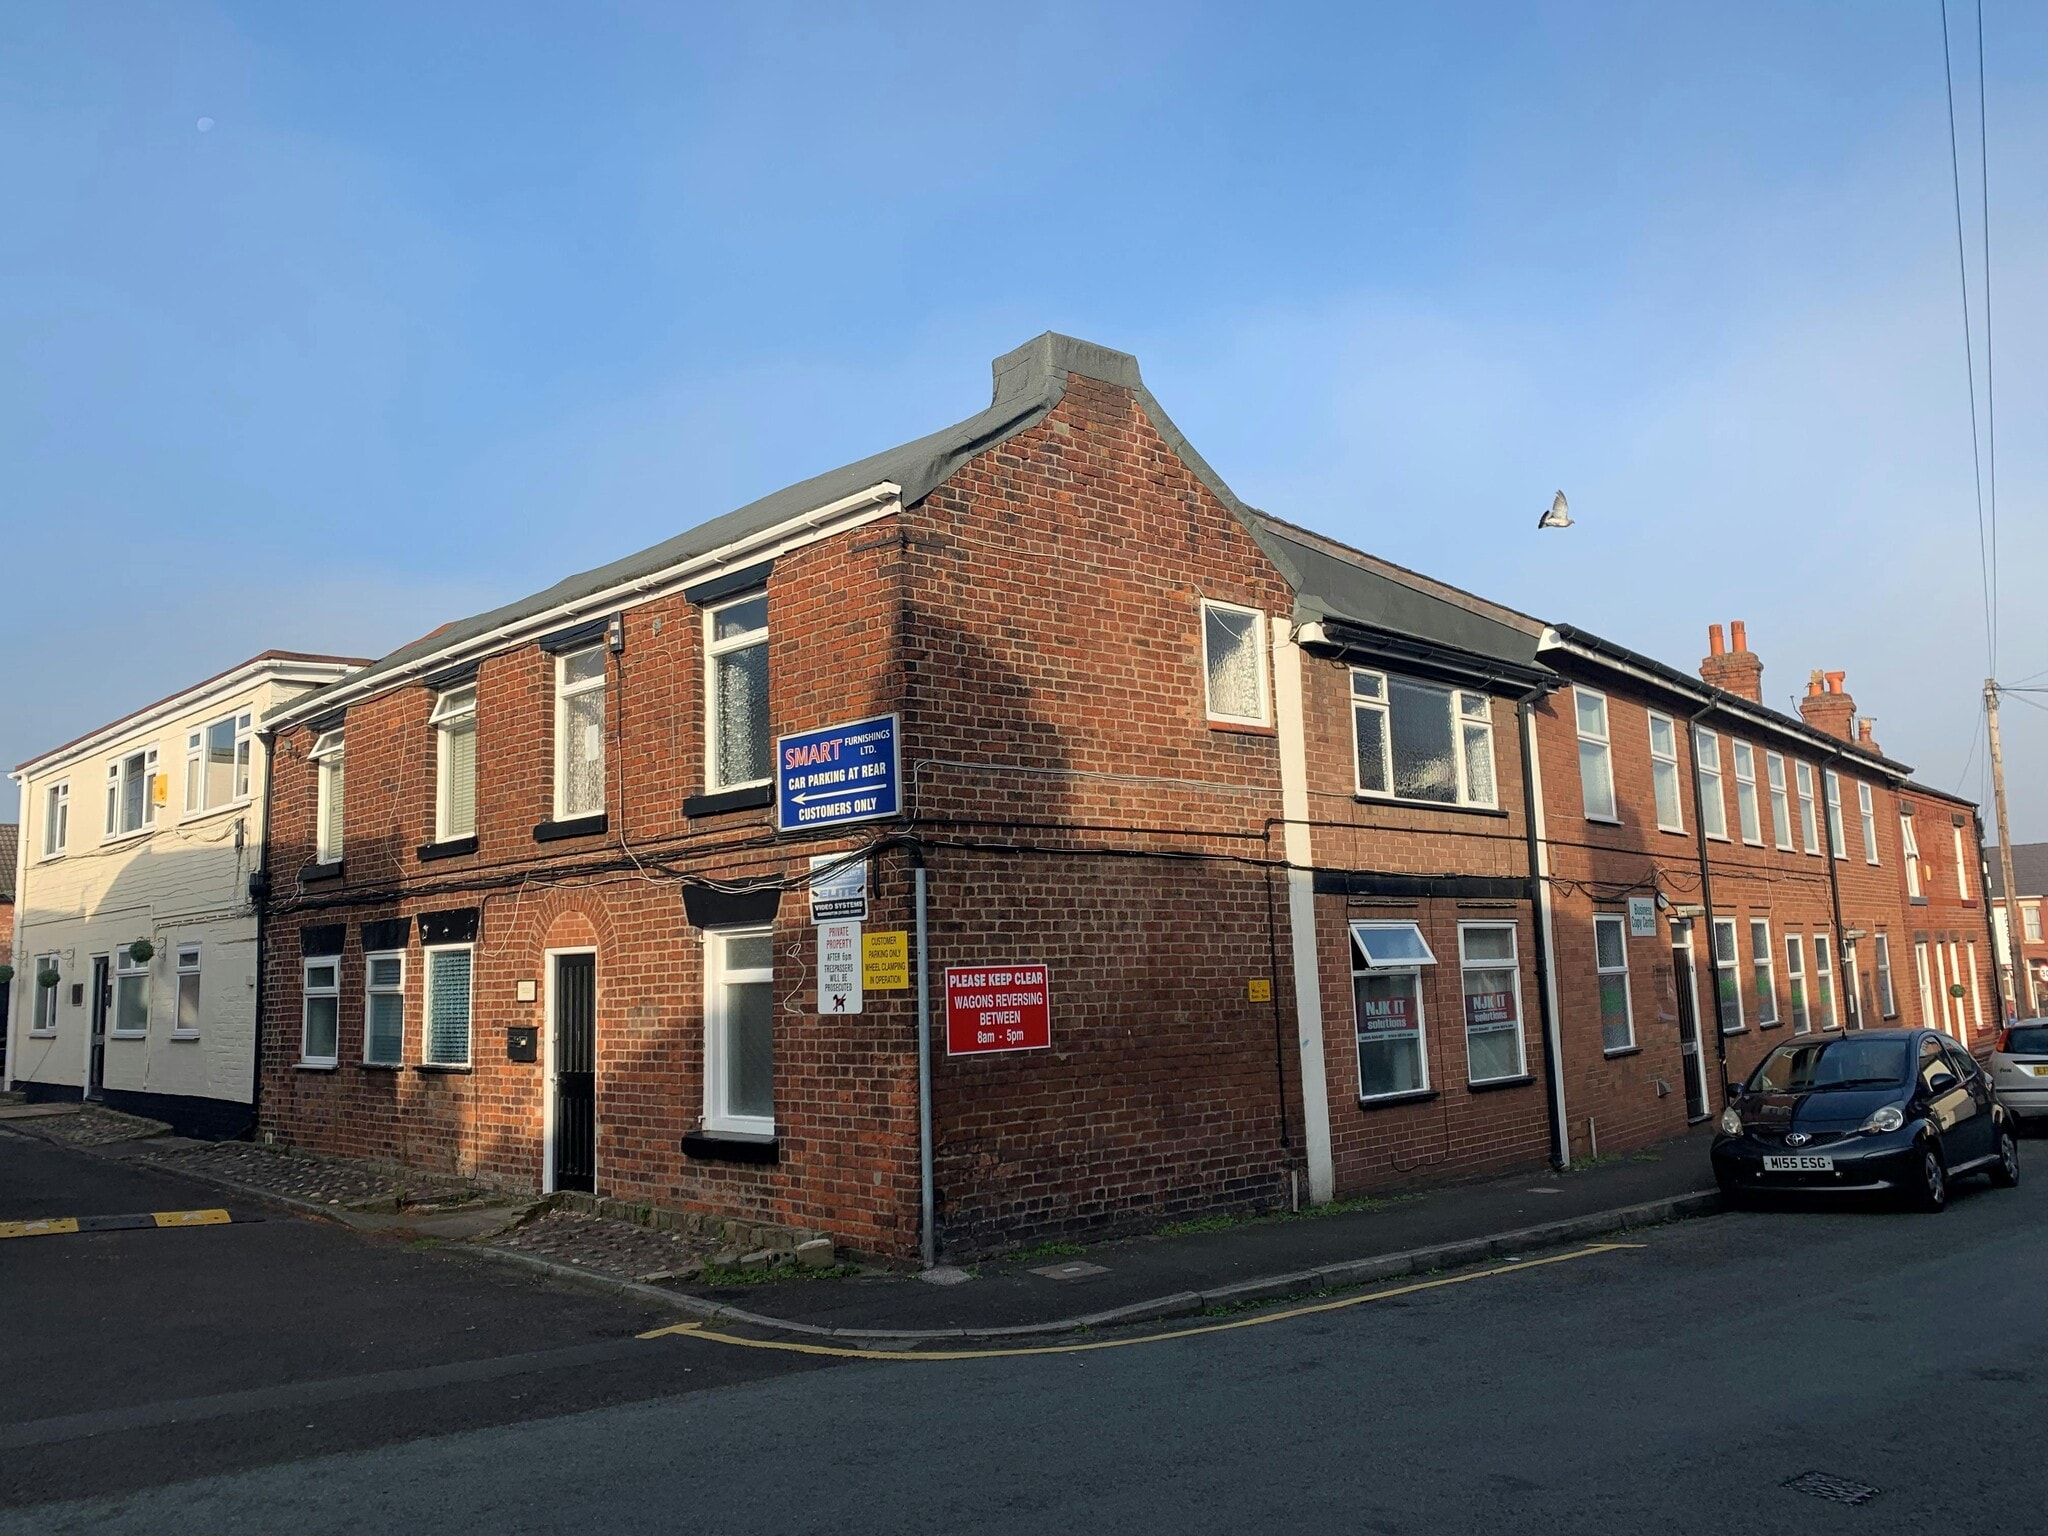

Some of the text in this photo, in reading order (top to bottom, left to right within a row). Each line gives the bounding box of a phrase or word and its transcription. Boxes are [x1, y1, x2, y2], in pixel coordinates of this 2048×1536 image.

[785, 730, 890, 770] SMART FURNISHINGS
[860, 745, 876, 756] LTD.
[788, 762, 886, 790] CAR PARKING AT REAR
[798, 798, 877, 820] CUSTOMERS ONLY
[834, 901, 863, 909] SYSTEMS
[1634, 904, 1652, 915] Business
[1632, 916, 1642, 930] Copy
[828, 927, 849, 937] PRIVATE
[826, 939, 852, 949] PROPERTY
[872, 936, 896, 946] CUSTOMER
[827, 953, 840, 961] AFTER
[869, 949, 901, 958] PARKING ONLY
[824, 964, 853, 973] TRESPASSERS
[865, 962, 905, 972] WHEEL CLAMPING
[830, 974, 847, 982] WILL BE
[870, 975, 901, 984] IN OPERATION
[950, 972, 1043, 988] PLEASE KEEP CLEAR
[825, 983, 852, 992] PROSECUTED
[954, 992, 1043, 1009] WAGONS REVERSING
[1473, 994, 1506, 1010] NJK IT
[1365, 1000, 1405, 1016] NJK IT
[980, 1011, 1020, 1025] BETWEEN
[1474, 1011, 1508, 1022] solutions
[1367, 1018, 1407, 1030] solutions
[977, 1031, 995, 1043] 8am
[1006, 1029, 1024, 1044] 5pm
[1801, 1158, 1826, 1168] ESG
